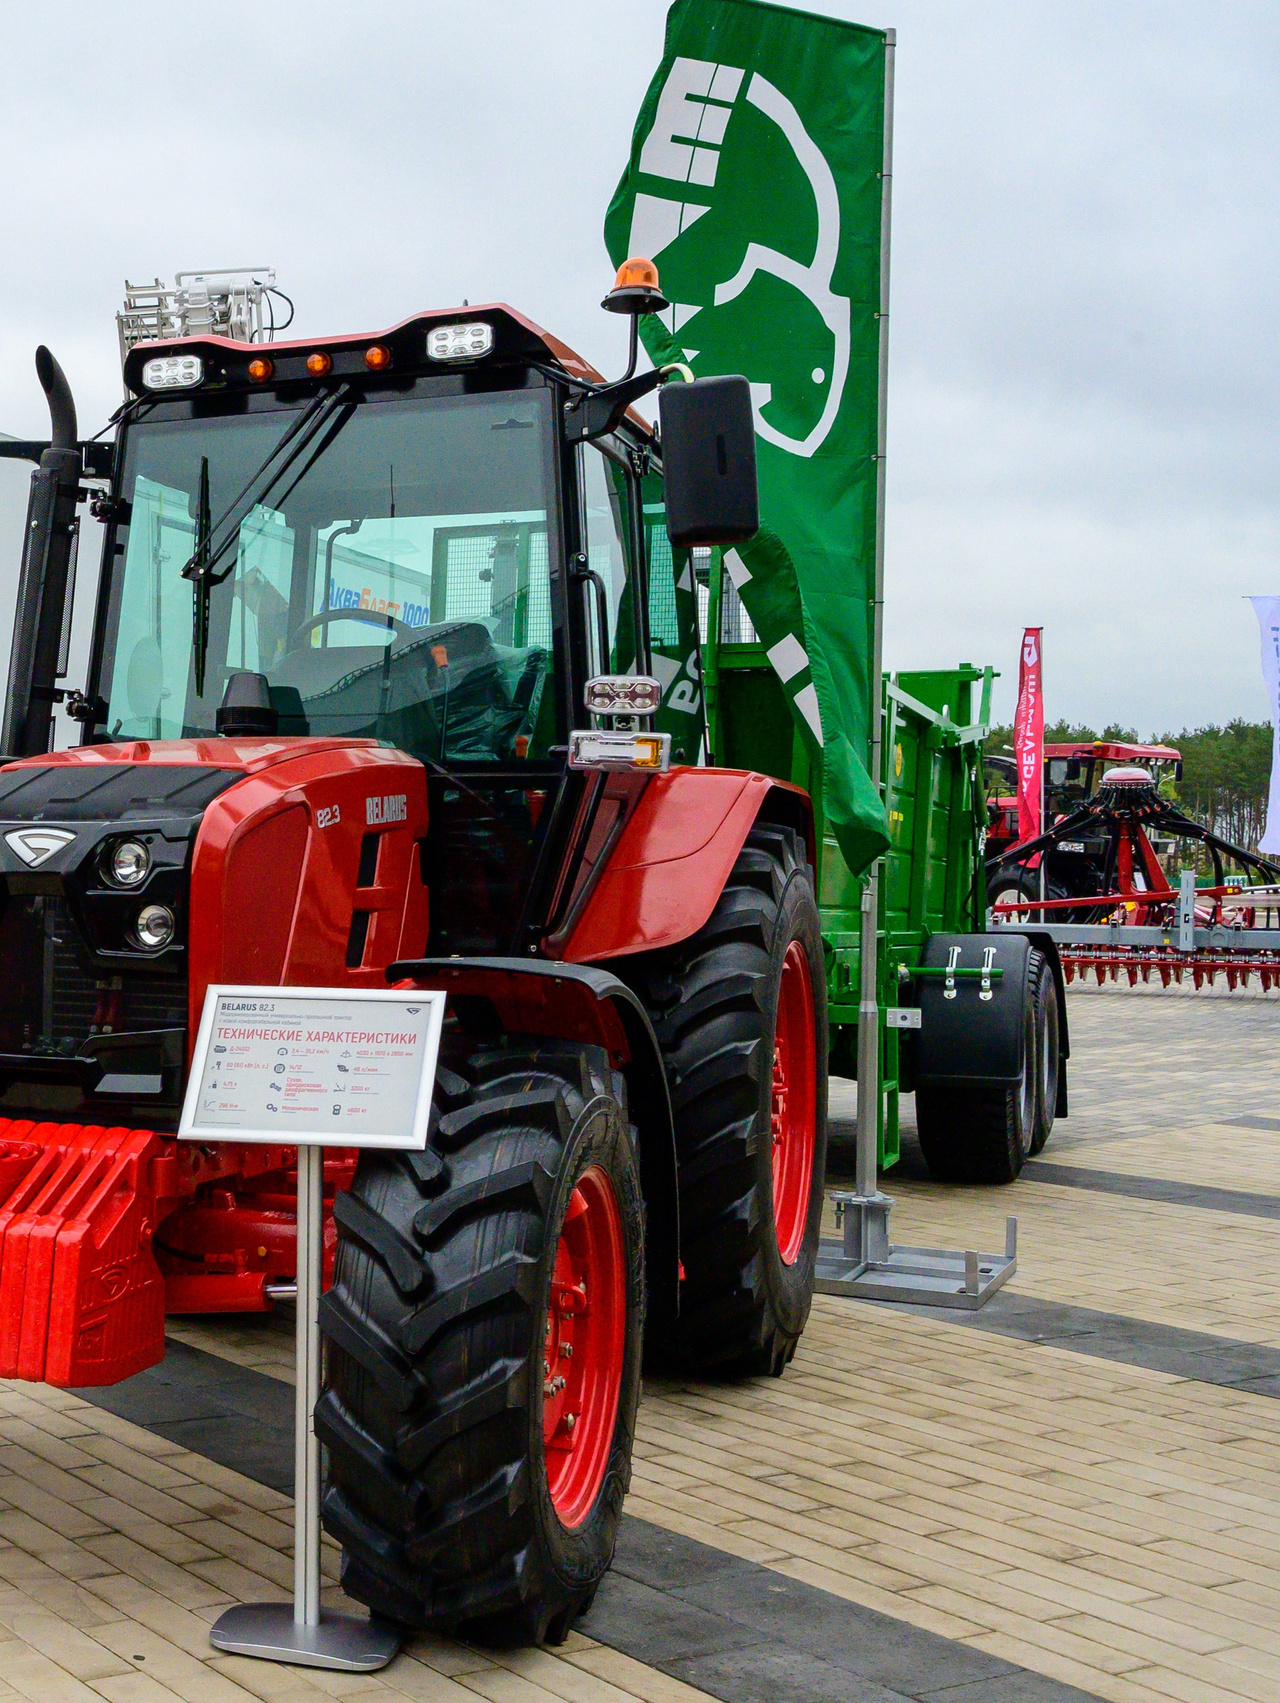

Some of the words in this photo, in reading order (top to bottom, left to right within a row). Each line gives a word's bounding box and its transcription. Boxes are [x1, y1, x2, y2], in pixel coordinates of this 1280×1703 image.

[317, 804, 340, 829] 82.3
[365, 794, 407, 825] BELARUS
[221, 1003, 257, 1011] BELARUS
[217, 1028, 303, 1041] ТЕХНИЧЕСКИЕ
[305, 1031, 418, 1044] ХАРАКТЕРИСТИКИ
